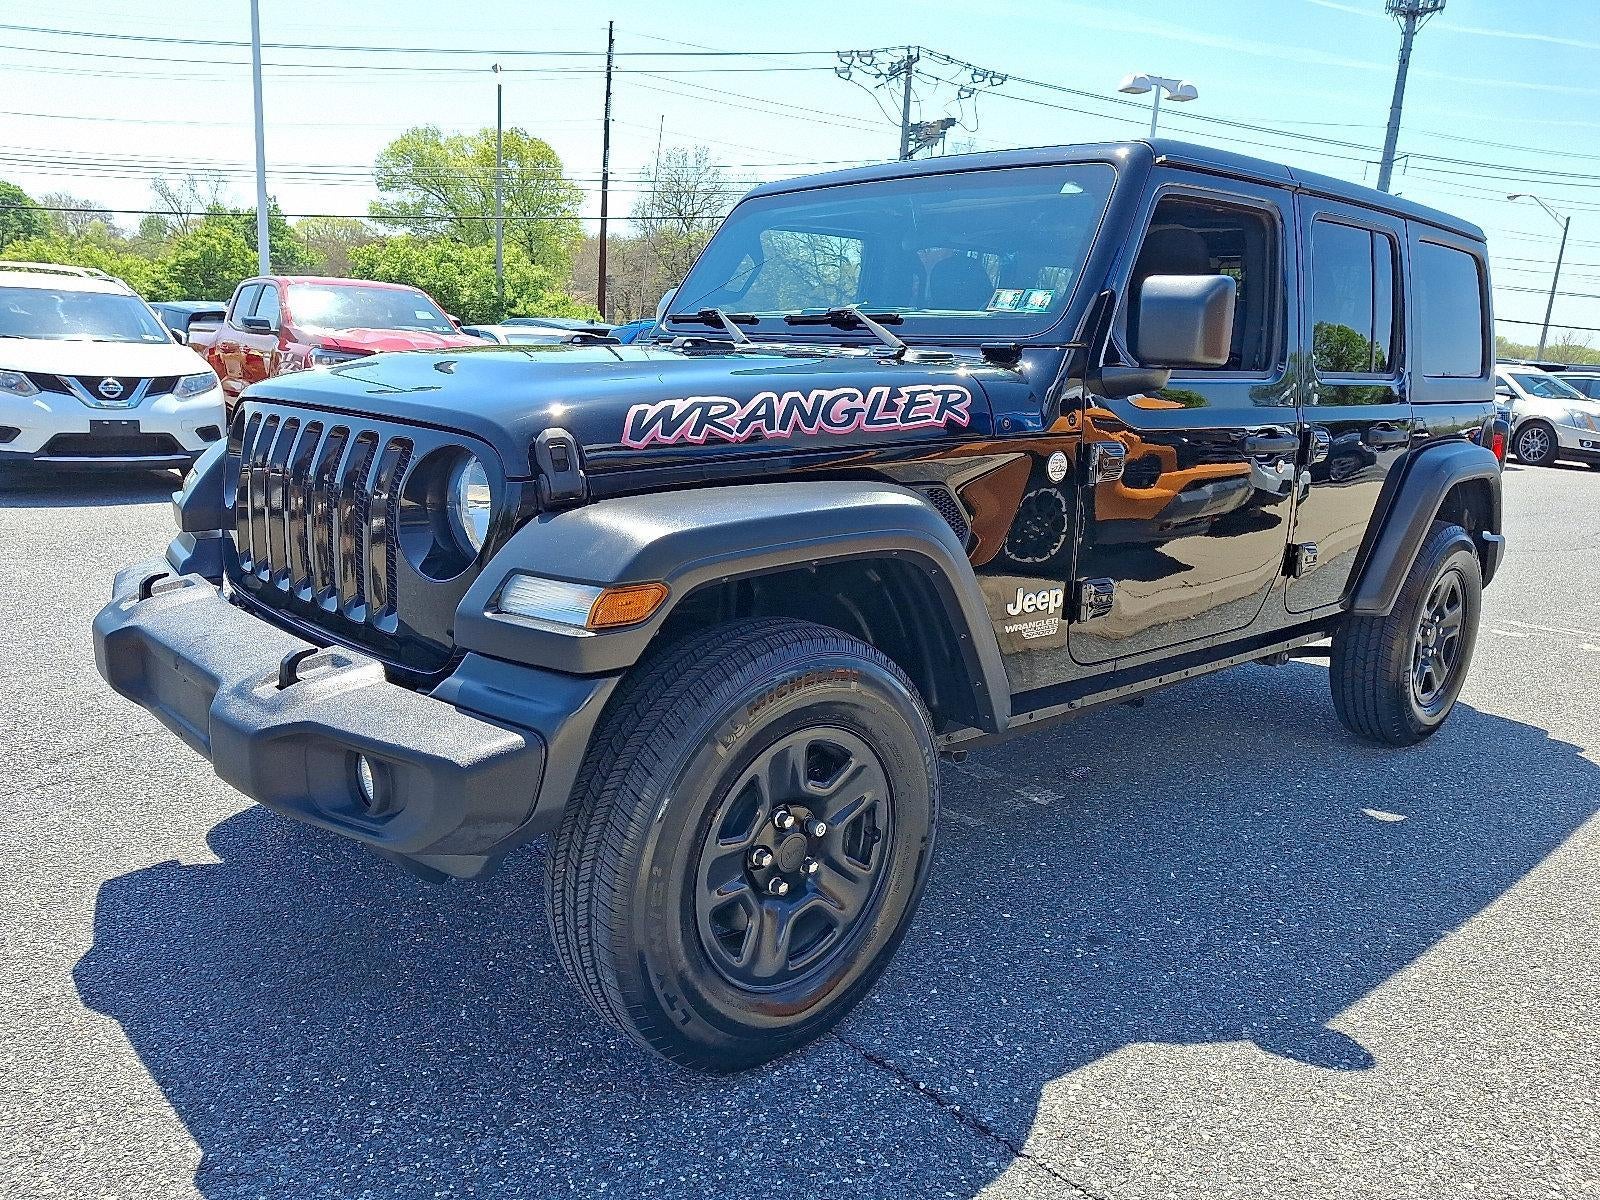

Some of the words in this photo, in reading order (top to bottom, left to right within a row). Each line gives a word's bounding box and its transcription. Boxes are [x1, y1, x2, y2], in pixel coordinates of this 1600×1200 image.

[622, 384, 971, 449] WRANGLER
[1006, 587, 1063, 616] Jeep
[1005, 617, 1059, 634] WRANGLER
